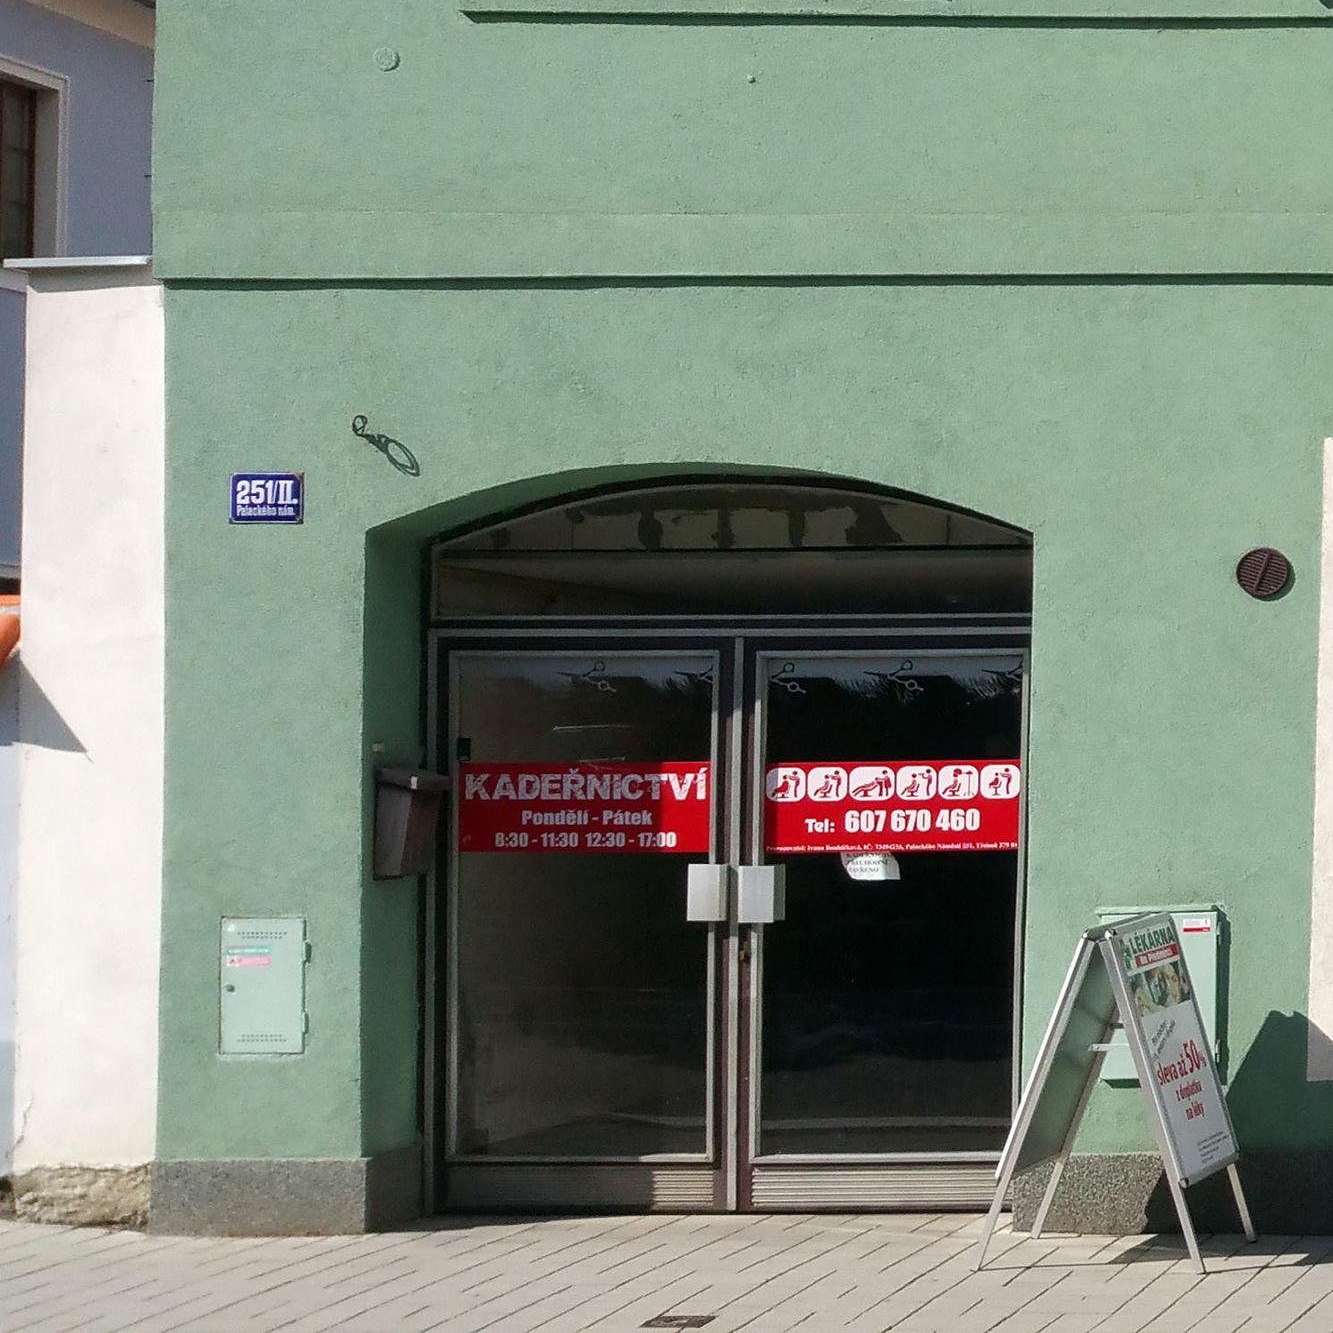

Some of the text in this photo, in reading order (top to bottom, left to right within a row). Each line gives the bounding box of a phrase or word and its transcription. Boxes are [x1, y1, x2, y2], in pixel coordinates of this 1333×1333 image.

[236, 479, 299, 505] 251/II.
[236, 504, 296, 517] Palackého nám.
[465, 767, 708, 800] KADEŘNICTVÍ
[522, 810, 588, 826] Pondělí
[602, 809, 652, 826] Pátek
[804, 808, 981, 833] Tel: 607 670 460
[495, 832, 528, 848] 8:30
[540, 832, 578, 848] 11:30
[585, 832, 625, 848] 12:30
[638, 832, 677, 848] 17:00
[1129, 926, 1176, 954] LÉKÁRNA
[1157, 1062, 1178, 1086] sleva
[1179, 1053, 1189, 1078] až
